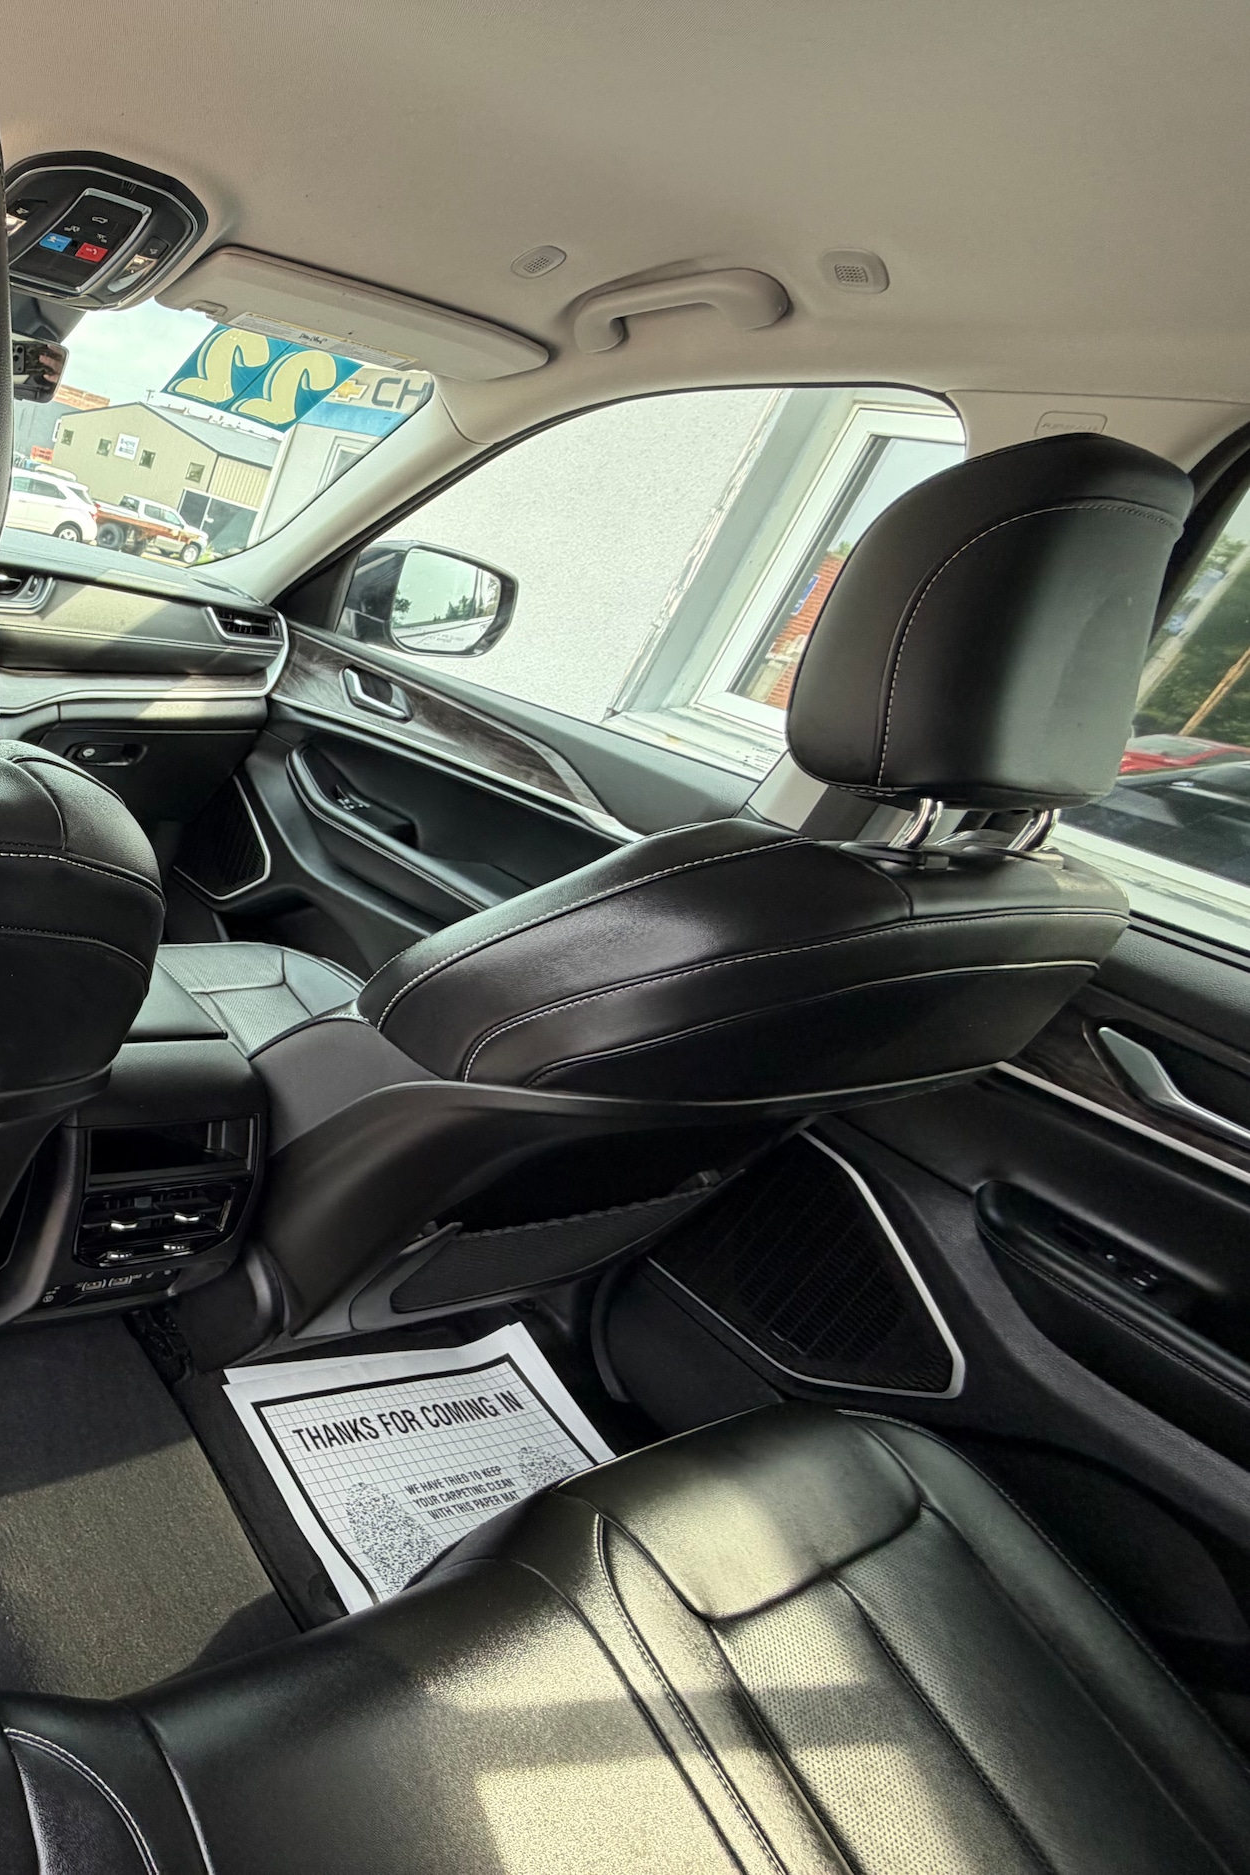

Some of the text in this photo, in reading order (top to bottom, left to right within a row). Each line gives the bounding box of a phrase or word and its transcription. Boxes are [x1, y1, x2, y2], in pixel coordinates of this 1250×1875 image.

[292, 1390, 524, 1452] THANKS FOR COMING IN
[404, 1465, 502, 1496] WE HAVE TRIED TO KEEP
[412, 1478, 516, 1509] YOUR CARPETING CLEAN
[427, 1490, 521, 1520] WITH THIS PAPER MAT
